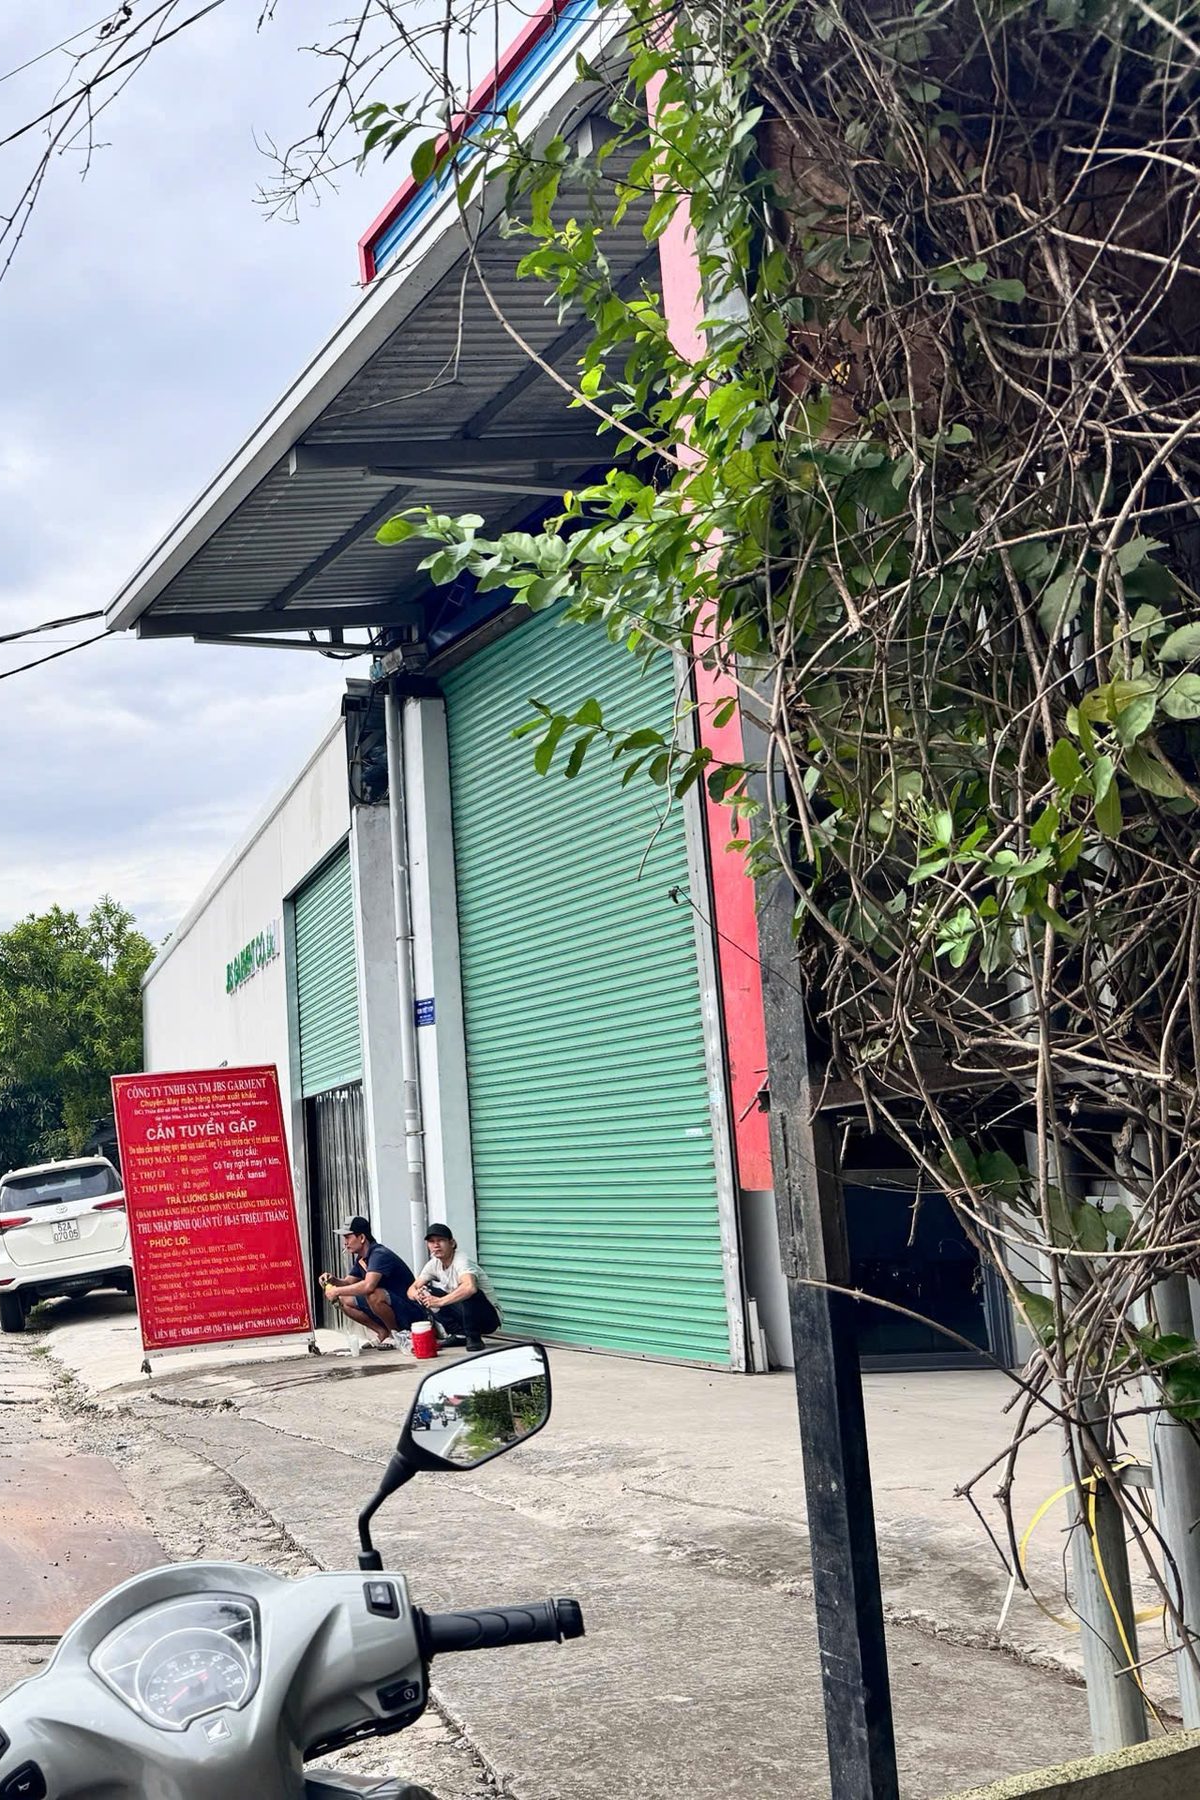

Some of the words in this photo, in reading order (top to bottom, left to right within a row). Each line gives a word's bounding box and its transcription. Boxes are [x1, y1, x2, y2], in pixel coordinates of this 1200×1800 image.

[126, 1085, 150, 1099] CÔNG
[151, 1086, 161, 1097] TY
[163, 1085, 186, 1096] TNHH
[187, 1083, 198, 1094] SX
[198, 1082, 211, 1093] TM
[212, 1081, 227, 1092] JBS
[227, 1078, 267, 1090] GARMENT
[178, 1117, 224, 1137] TUYỂN
[229, 1116, 257, 1133] GẤP
[154, 1156, 172, 1164] MAY
[191, 1214, 212, 1231] QUÂN
[264, 1207, 290, 1222] THÁNG
[149, 1236, 174, 1248] PHÚC
